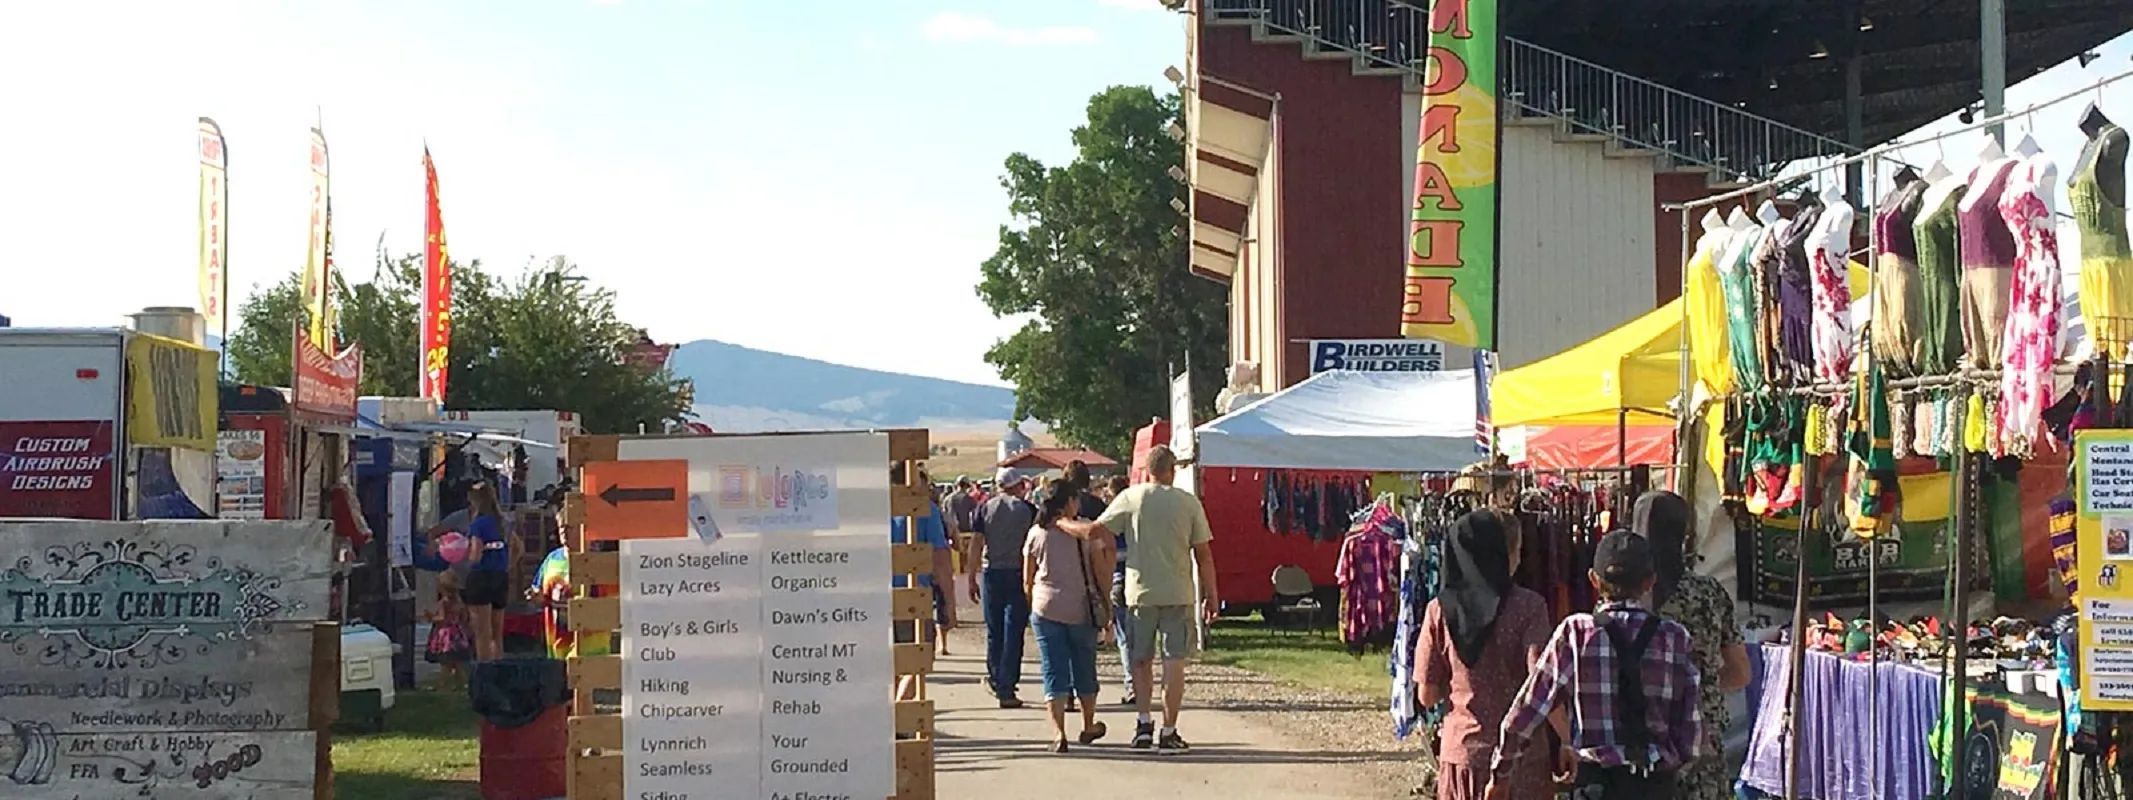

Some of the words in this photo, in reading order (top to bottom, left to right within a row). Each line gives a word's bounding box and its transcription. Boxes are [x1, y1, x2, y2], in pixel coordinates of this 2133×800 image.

[1314, 342, 1442, 366] BIRDWELL
[15, 437, 91, 452] CUSTOM
[2, 456, 104, 471] AIRBRUSH
[11, 475, 94, 489] DESIGNS
[640, 555, 673, 569] Zion
[678, 552, 749, 570] Stageline
[771, 550, 849, 565] Kettlecare
[641, 582, 674, 597] Lazy
[679, 579, 721, 593] Acres
[771, 574, 838, 592] Organics
[7, 588, 101, 622] TRADE
[116, 591, 221, 621] CENTER
[772, 610, 828, 625] Dawn's
[832, 607, 868, 622] Gifts
[641, 622, 682, 638] Boy's
[687, 621, 698, 635] &
[704, 619, 738, 634] Girls
[641, 647, 676, 661] Club
[772, 643, 828, 660] Central
[832, 643, 857, 657] MT
[772, 670, 831, 686] Nursing
[836, 668, 848, 682] &
[641, 679, 690, 695] Hiking
[641, 703, 724, 720] Chipcarver
[772, 700, 822, 715] Rehab
[70, 711, 162, 726] Needlework
[167, 712, 177, 725] &
[183, 709, 286, 729] Photography
[70, 738, 94, 752] Art
[104, 736, 146, 751] Craft
[151, 738, 160, 751] &
[167, 736, 214, 757] Hobby
[641, 736, 707, 753] Lynnrich
[772, 734, 808, 748] Your
[70, 764, 100, 779] FFA
[640, 761, 713, 776] Seamless
[771, 758, 849, 773] Grounded
